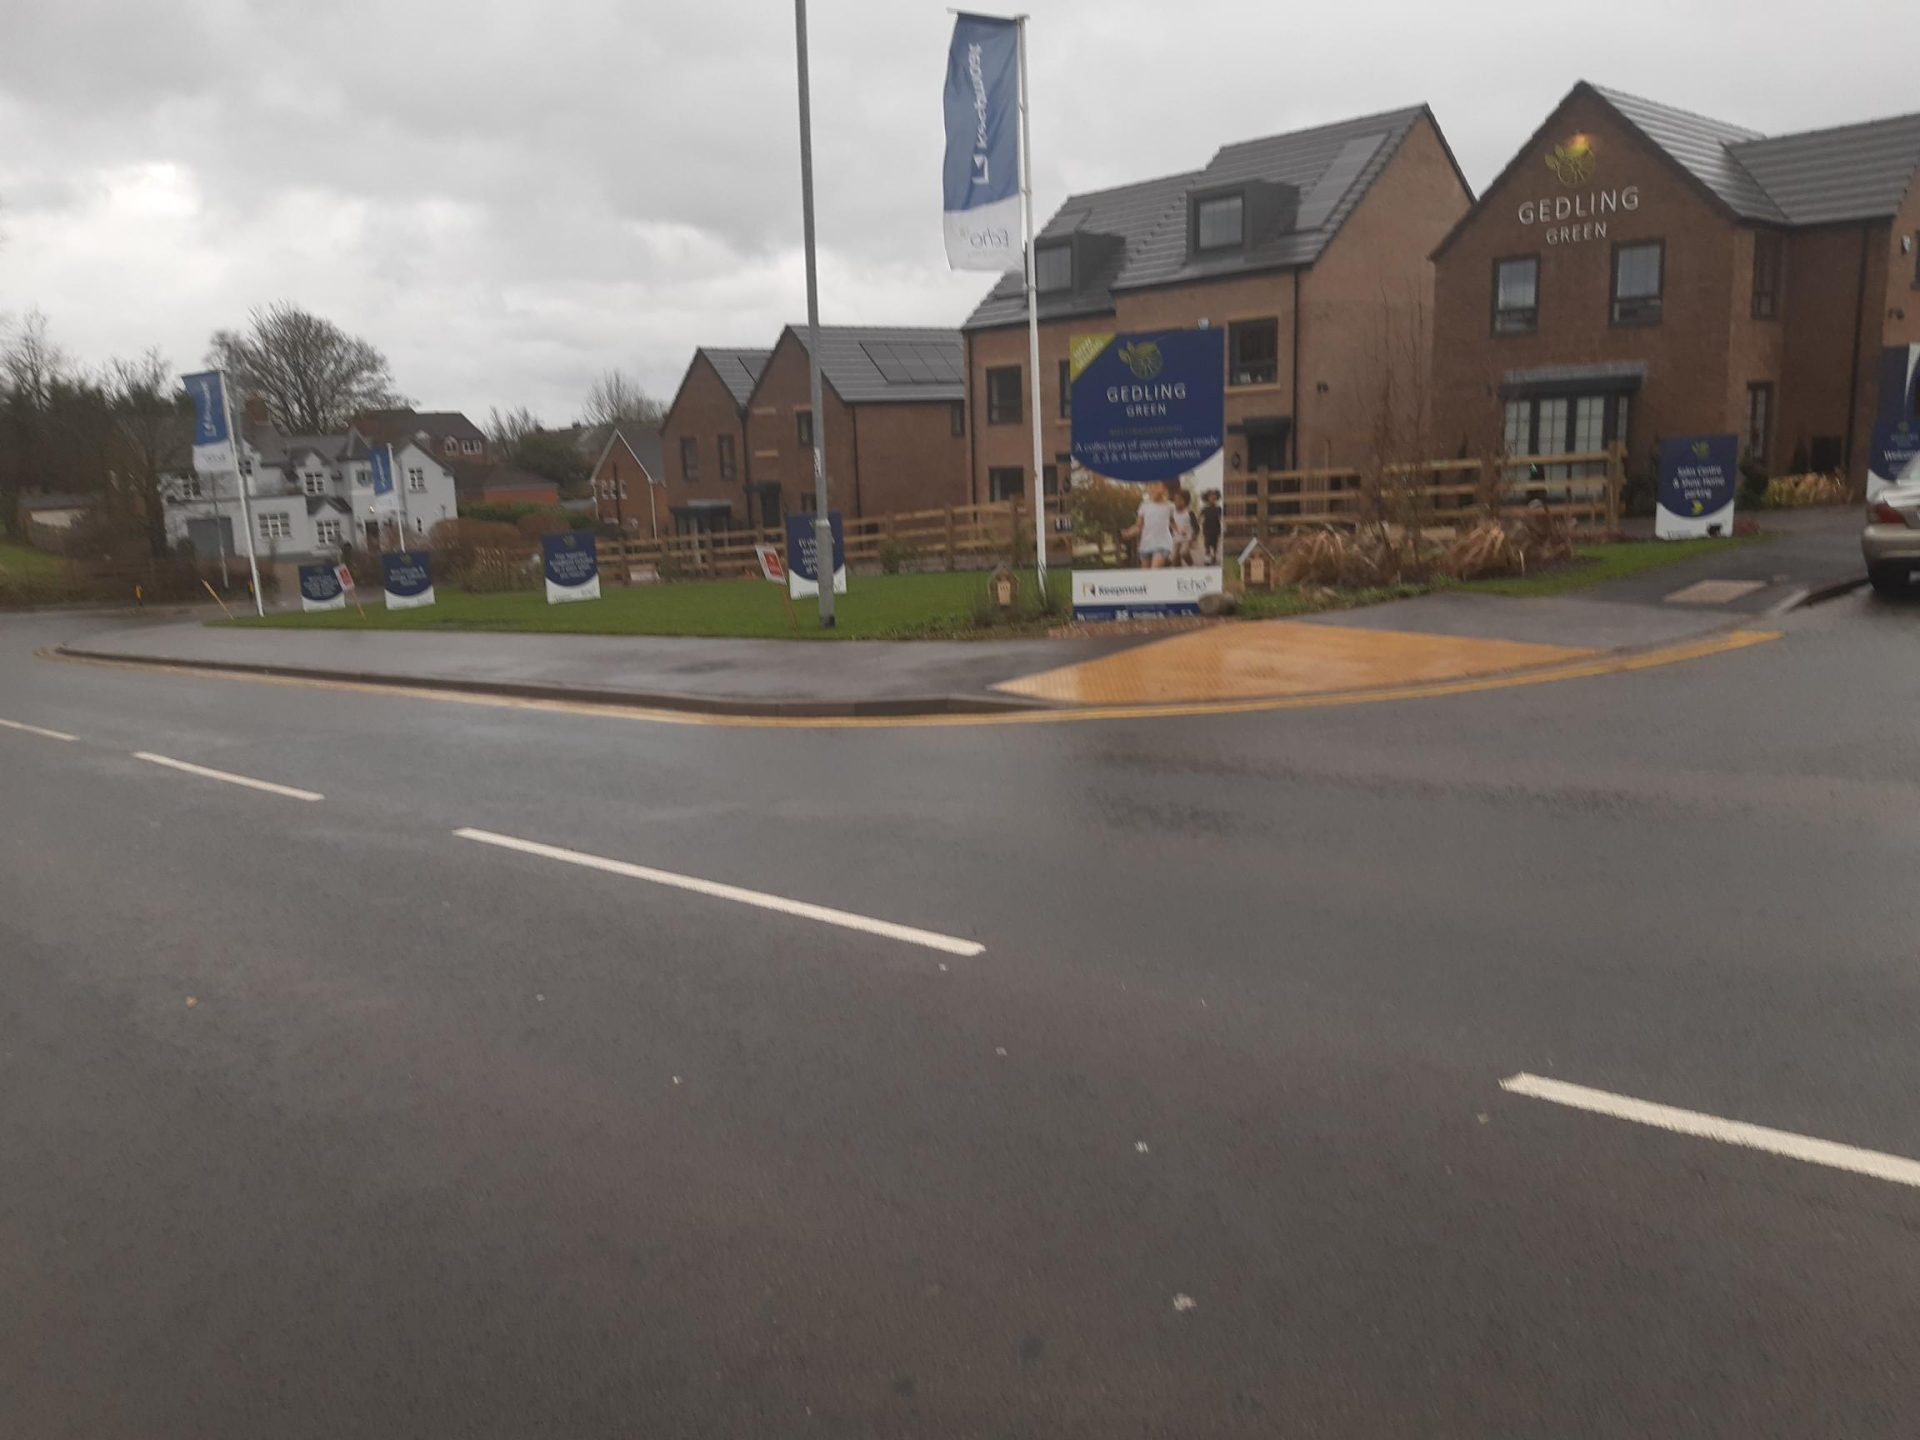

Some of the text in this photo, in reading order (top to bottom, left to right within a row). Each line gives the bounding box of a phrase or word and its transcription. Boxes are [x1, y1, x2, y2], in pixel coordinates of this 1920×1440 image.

[1518, 185, 1639, 225] GEDLING
[1546, 221, 1607, 245] GREEN
[1107, 383, 1186, 402] GEDLING
[1126, 403, 1166, 417] GREEN
[1127, 440, 1137, 451] of
[1098, 584, 1148, 597] Keepmoat
[1177, 576, 1207, 593] Echo
